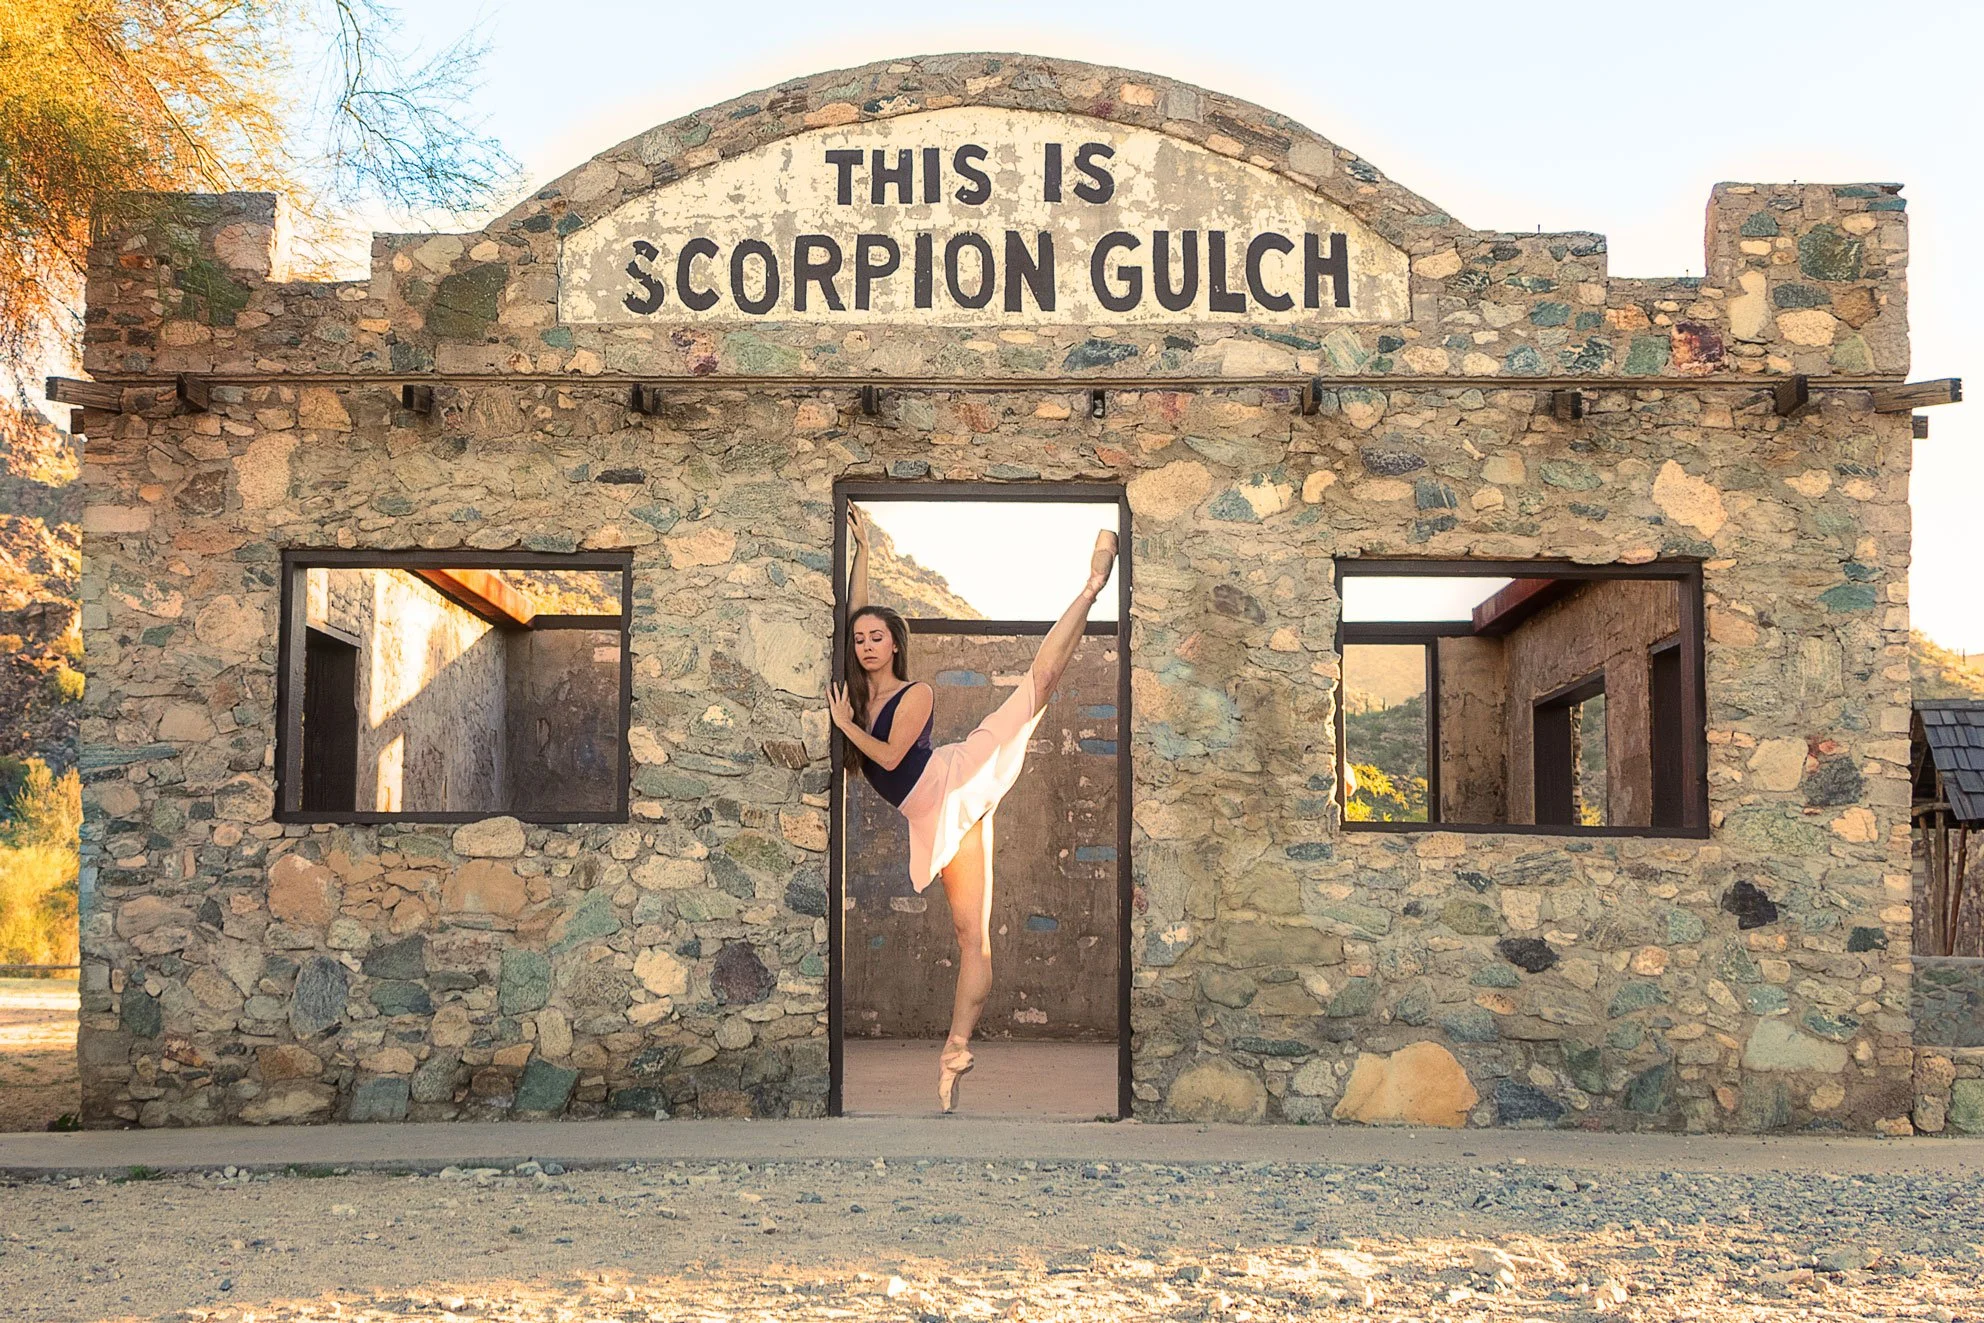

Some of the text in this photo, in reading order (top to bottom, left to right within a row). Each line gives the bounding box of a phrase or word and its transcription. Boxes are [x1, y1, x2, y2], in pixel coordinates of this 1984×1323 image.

[825, 142, 1116, 206] THIS IS
[622, 230, 1352, 316] SCORPION GULCH
